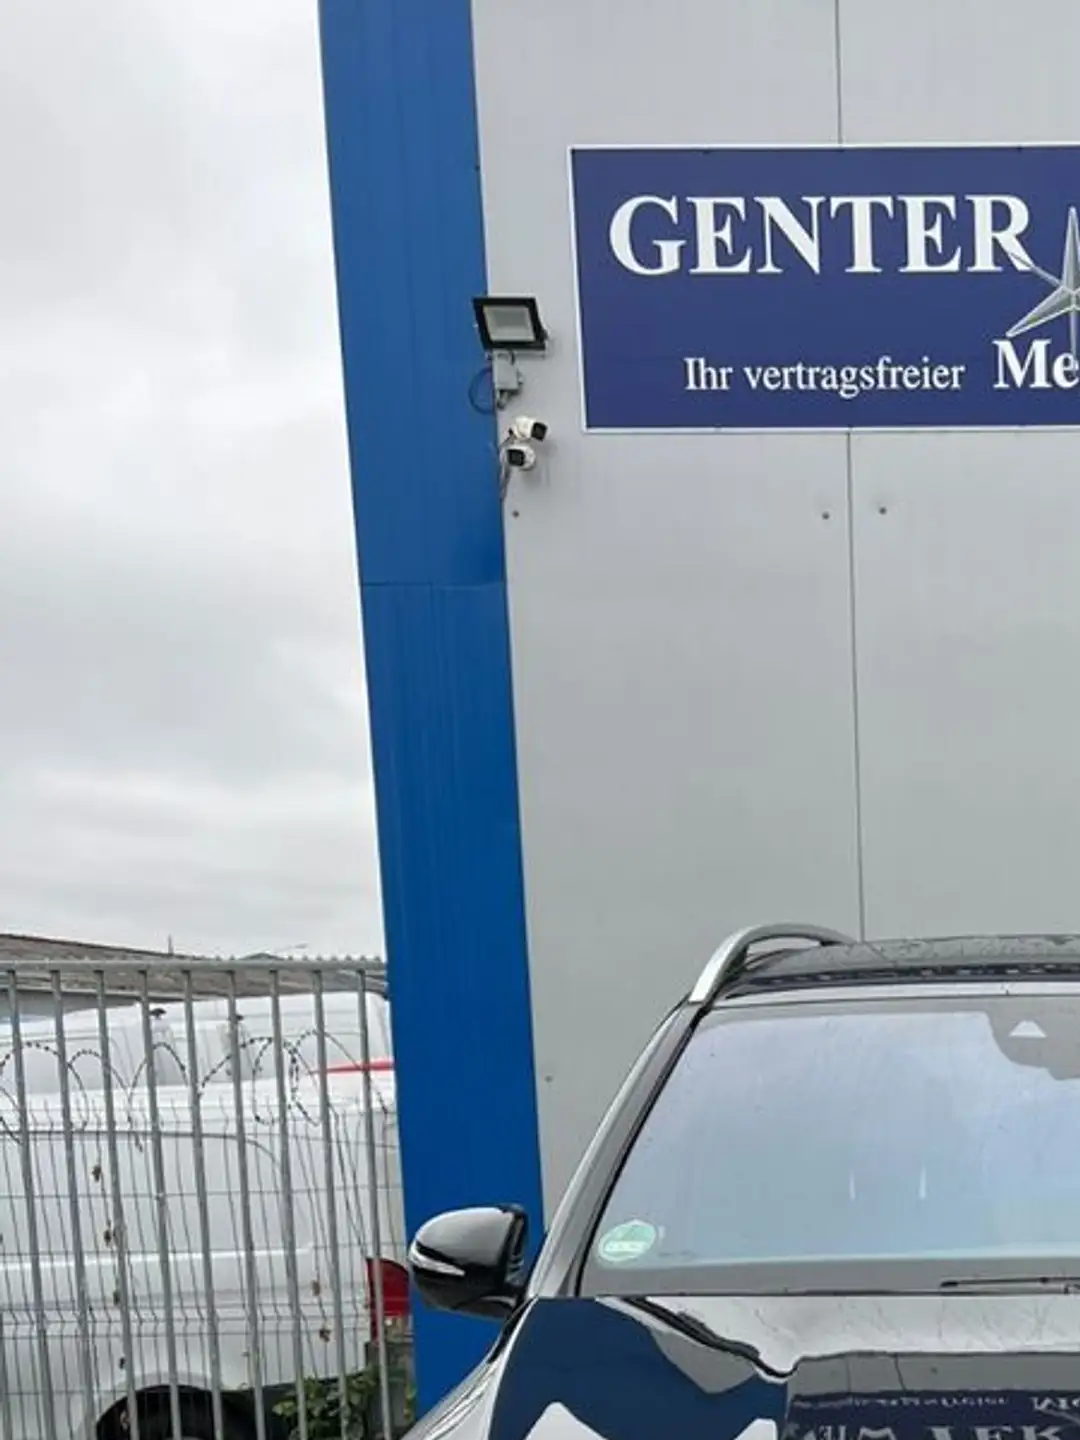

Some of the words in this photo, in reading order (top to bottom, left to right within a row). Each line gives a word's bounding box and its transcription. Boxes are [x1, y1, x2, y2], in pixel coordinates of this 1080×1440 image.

[608, 193, 1033, 276] GENTER
[684, 356, 734, 391] Ihr
[743, 355, 966, 399] vertragsfreier
